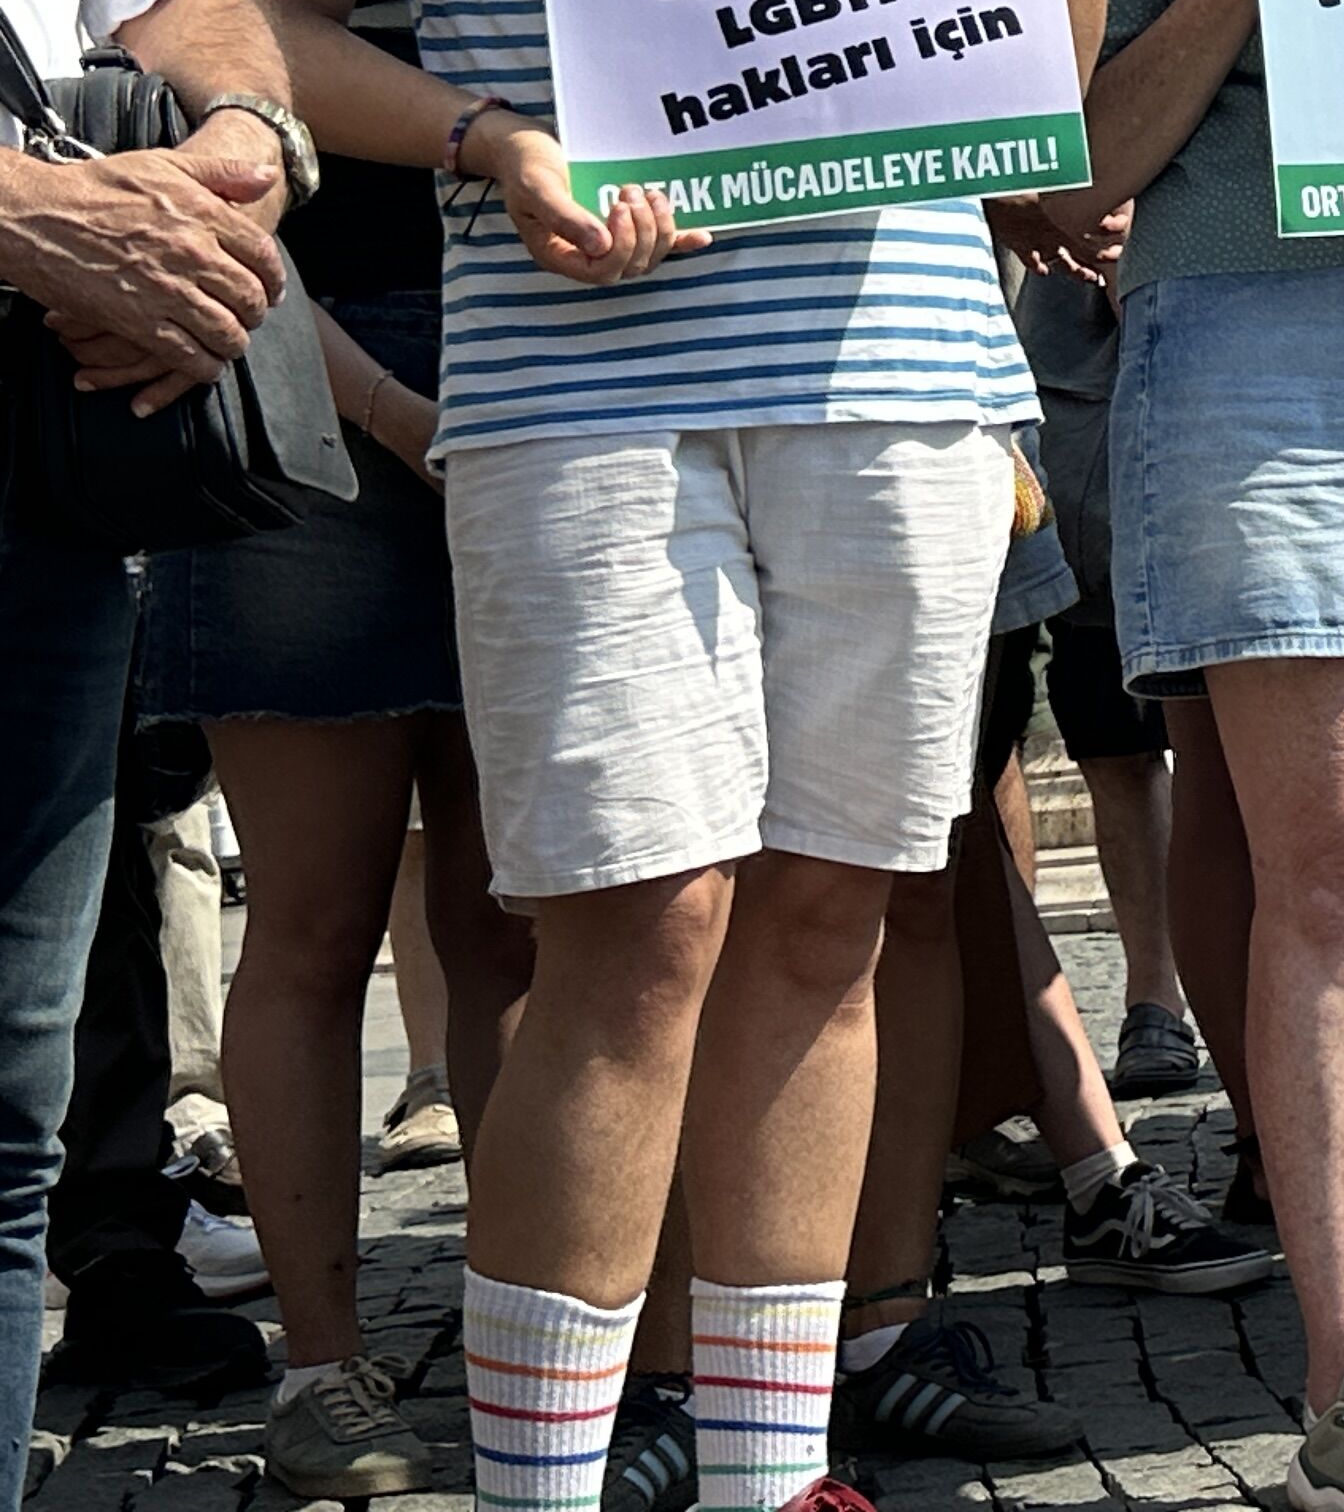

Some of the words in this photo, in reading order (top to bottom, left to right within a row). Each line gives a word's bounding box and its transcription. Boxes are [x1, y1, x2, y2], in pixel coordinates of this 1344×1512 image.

[660, 35, 897, 136] hakları
[912, 5, 1024, 62] için
[722, 150, 946, 208] MÜCADELEYE
[952, 136, 1060, 181] KATIL!
